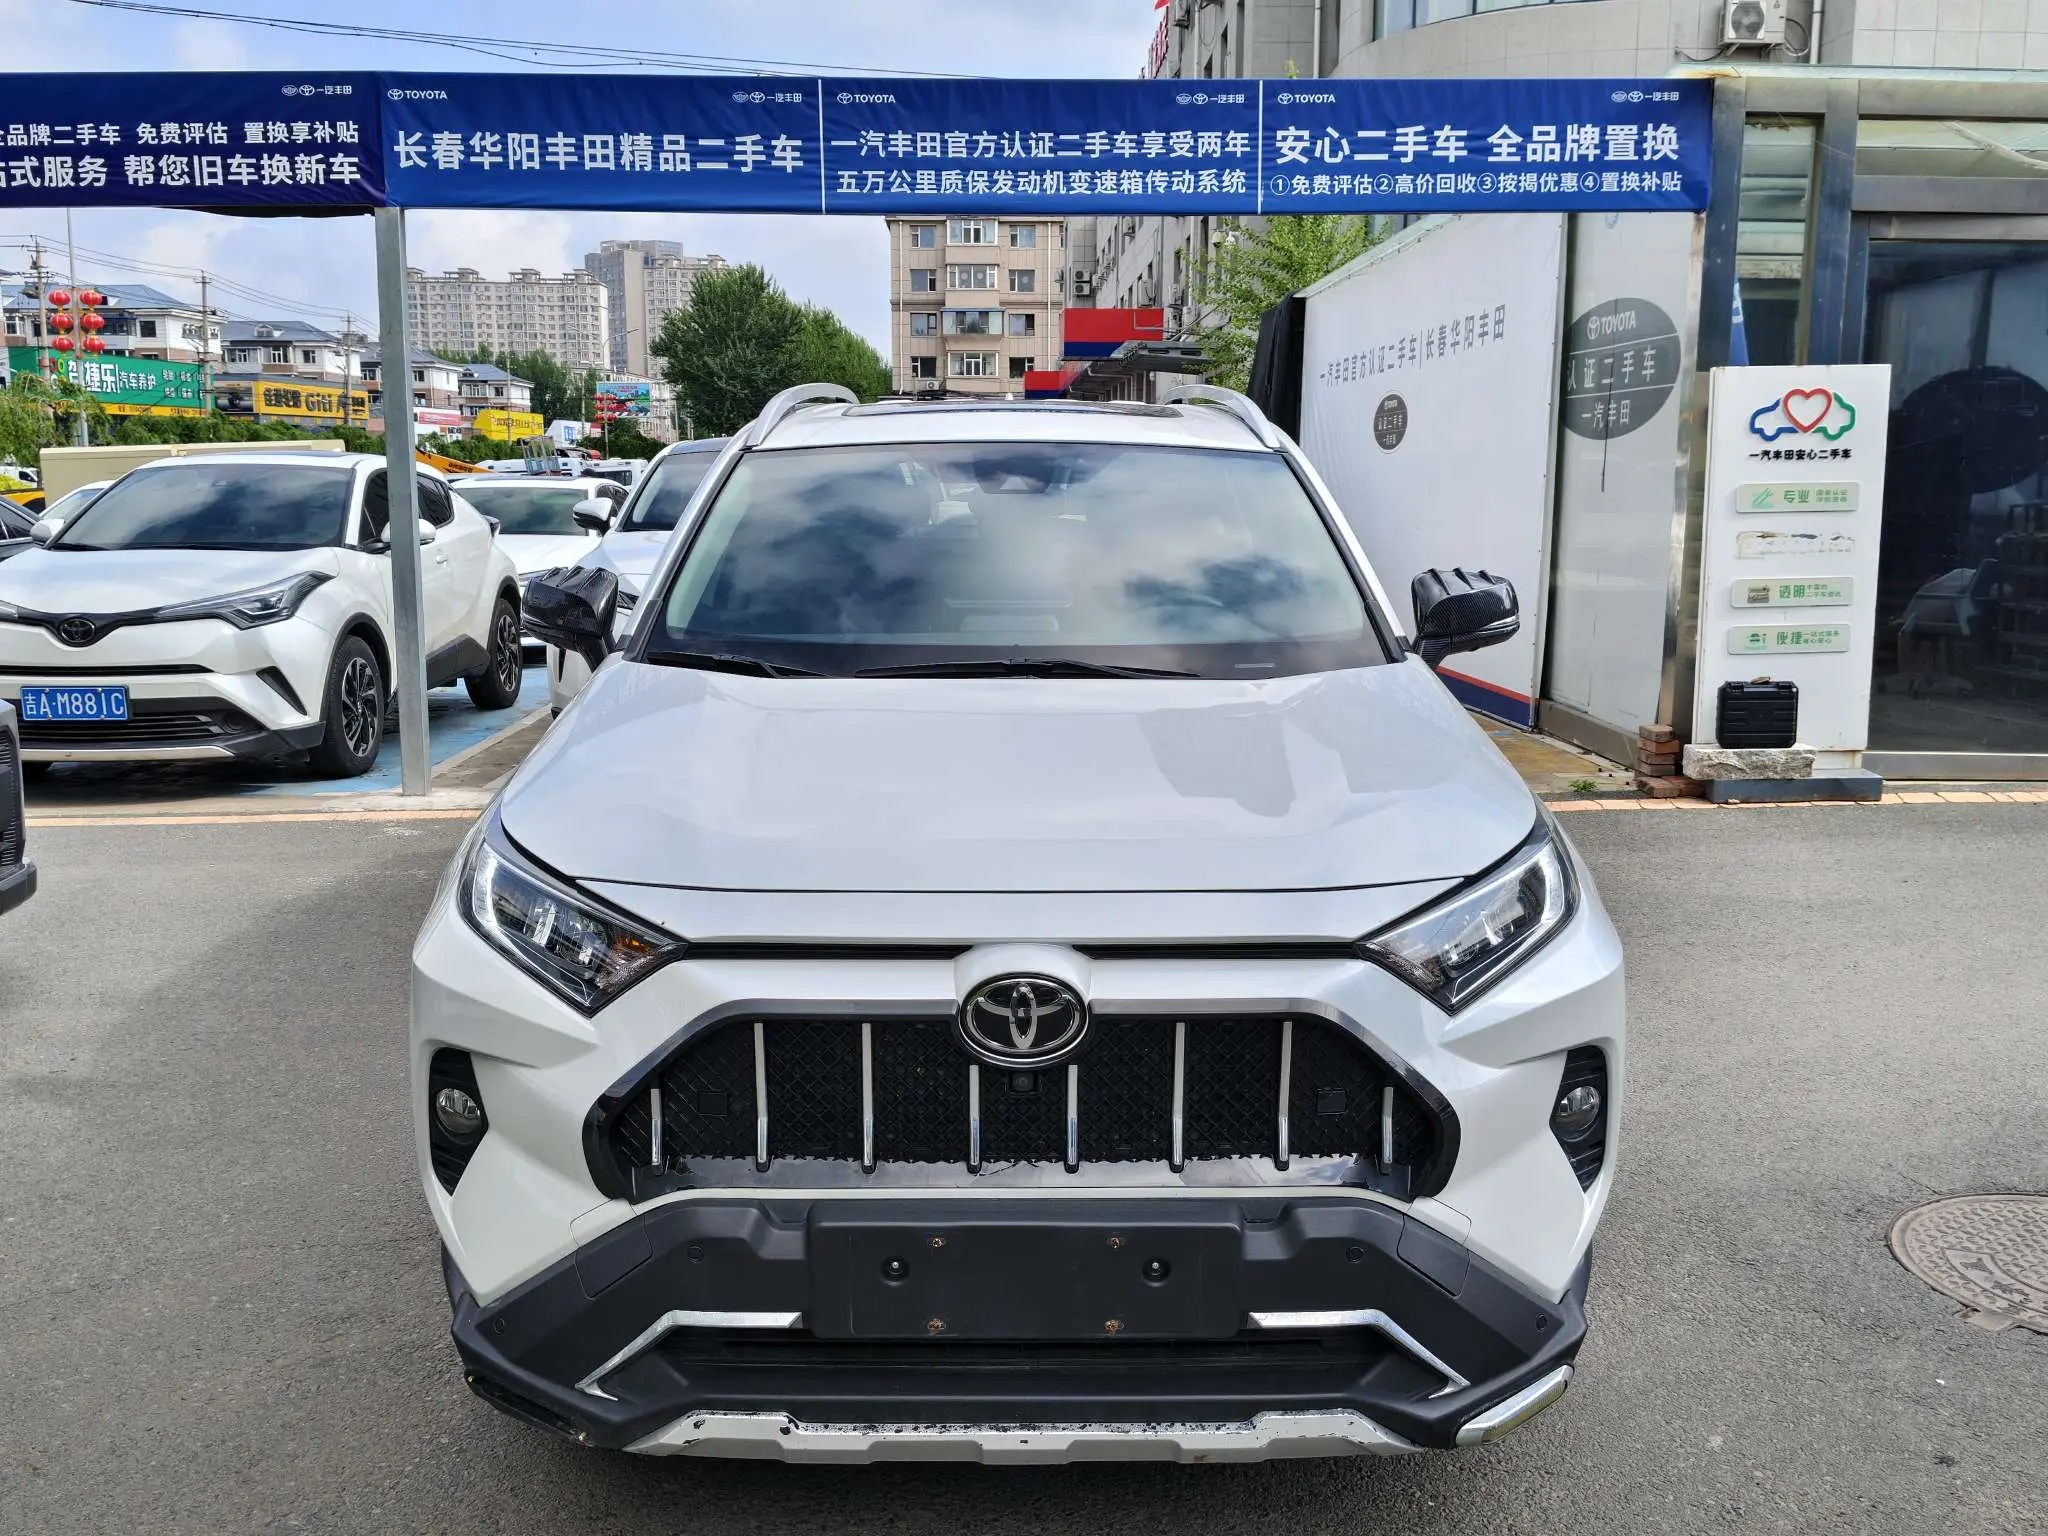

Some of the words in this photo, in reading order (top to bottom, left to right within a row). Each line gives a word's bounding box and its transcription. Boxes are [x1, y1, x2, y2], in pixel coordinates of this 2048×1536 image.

[314, 85, 353, 96] 一汽丰田
[404, 90, 448, 100] TOYOTA
[766, 92, 803, 103] 一汽丰田
[1644, 91, 1681, 102] 一汽丰田
[853, 94, 896, 104] TOYOTA
[1209, 93, 1246, 104] 一汽丰田
[1294, 93, 1336, 104] TOYOTA
[0, 123, 121, 147] 品牌二手车
[136, 121, 228, 145] 免费评估
[243, 120, 359, 144] 置换享补贴
[831, 130, 1251, 159] 一汽丰田官方认证二手车享受两年
[1275, 125, 1468, 165] 安心二手车
[1486, 123, 1680, 163] 全品牌置换
[393, 130, 804, 173] 长春华阳丰田精品二手车
[0, 154, 108, 188] 式服务
[123, 153, 361, 187] 帮您旧车换新车
[836, 168, 1247, 195] 五万公里质保发动机变速箱传动系统
[1601, 310, 1637, 336] TOYOTA
[1581, 400, 1631, 428] 一汽丰田
[1749, 448, 1853, 461] 一汽丰田安心二手车
[1783, 490, 1810, 503] 专业
[1779, 584, 1805, 599] 透明
